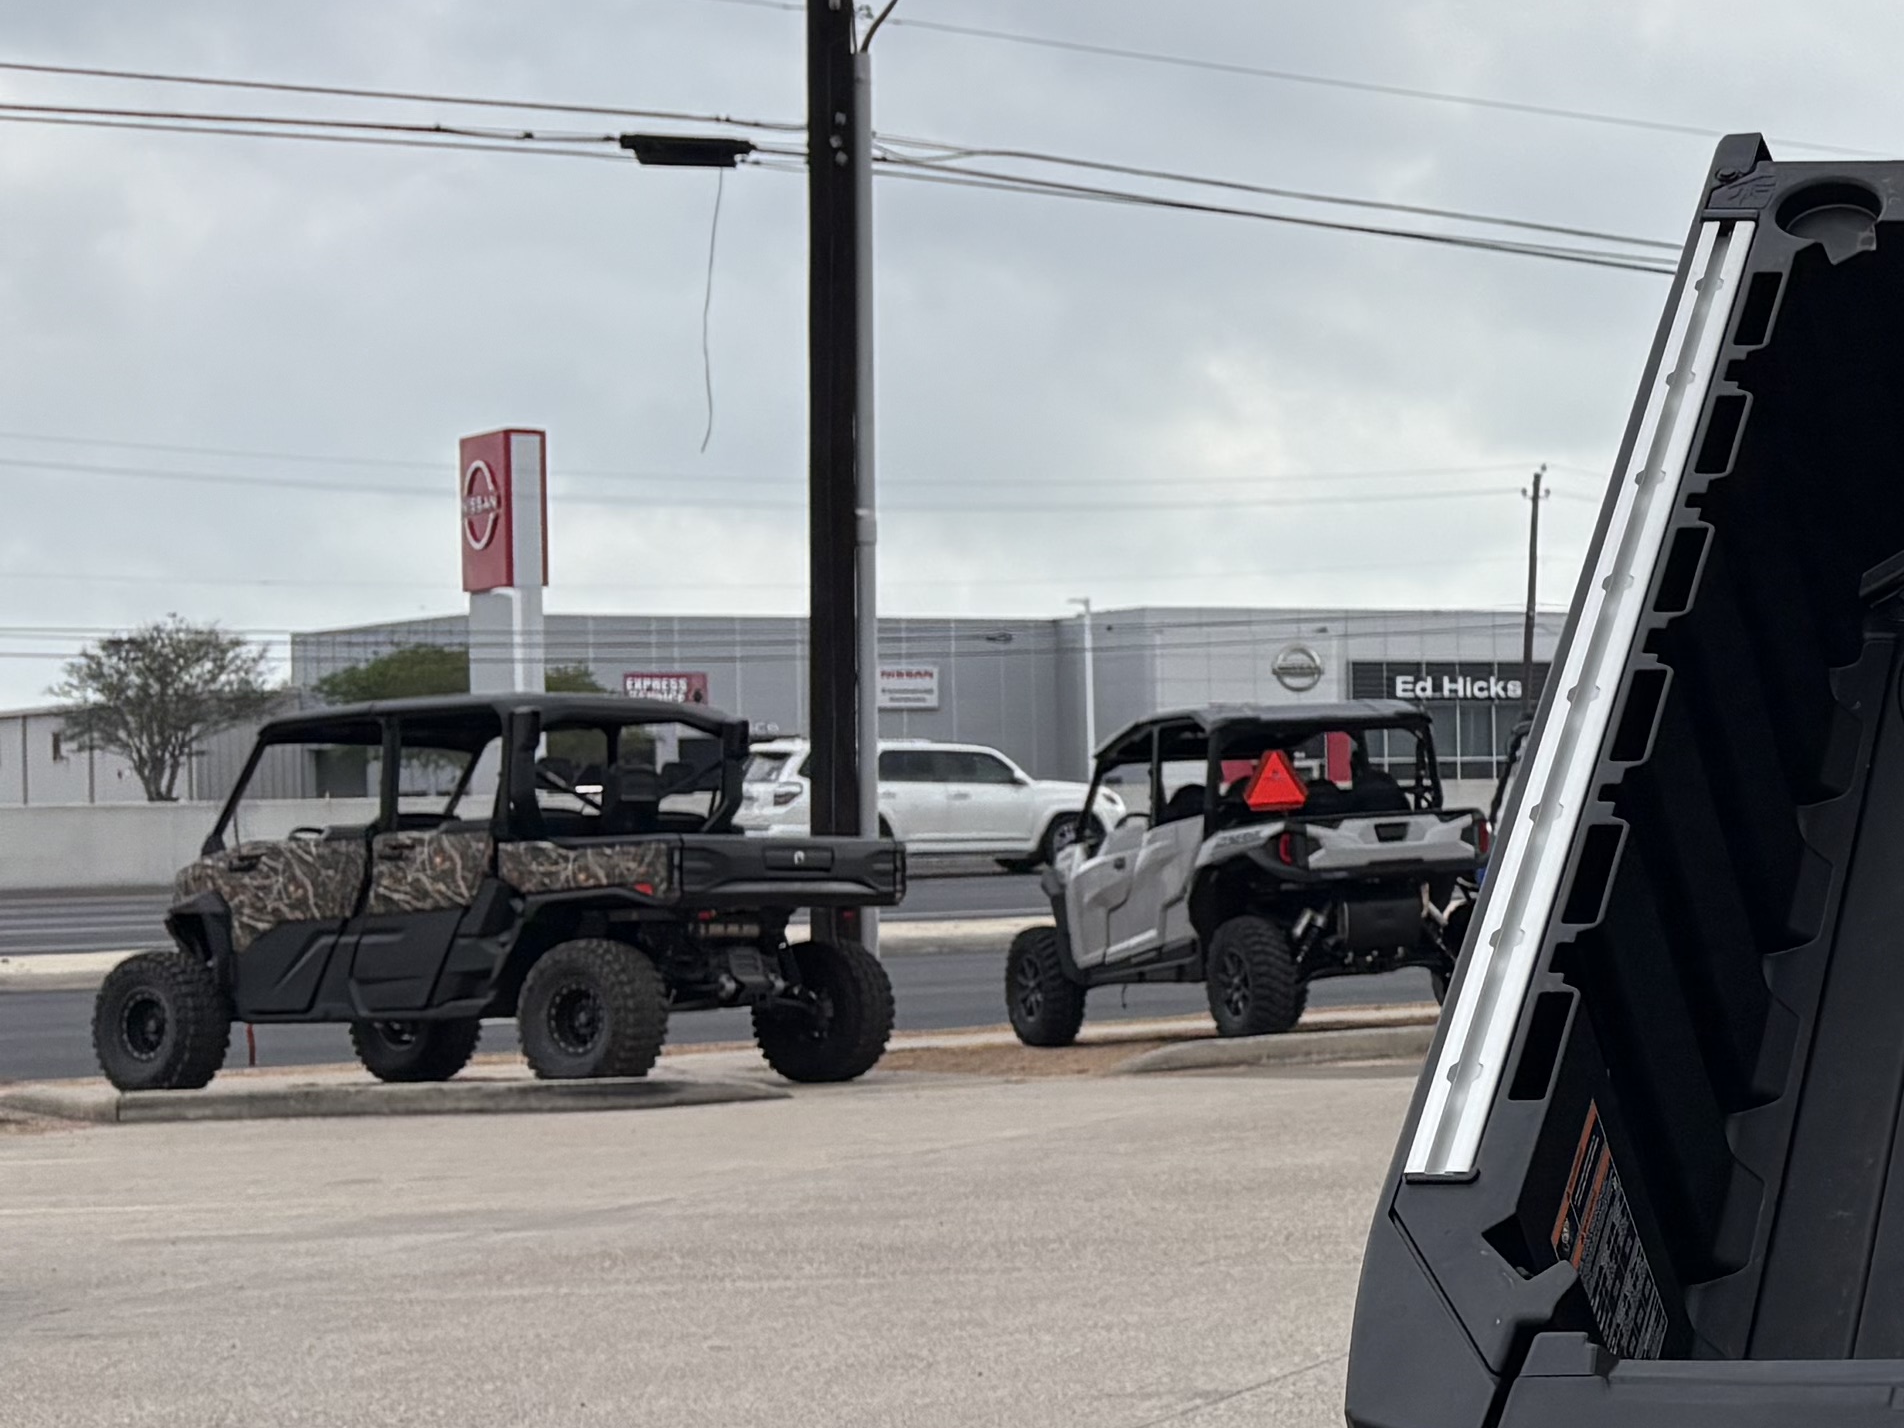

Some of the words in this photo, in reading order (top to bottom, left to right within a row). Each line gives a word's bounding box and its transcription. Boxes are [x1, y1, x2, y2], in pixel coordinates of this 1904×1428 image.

[626, 677, 687, 690] EXPRESS
[1396, 675, 1432, 698] Ed
[1443, 675, 1522, 698] Hicks
